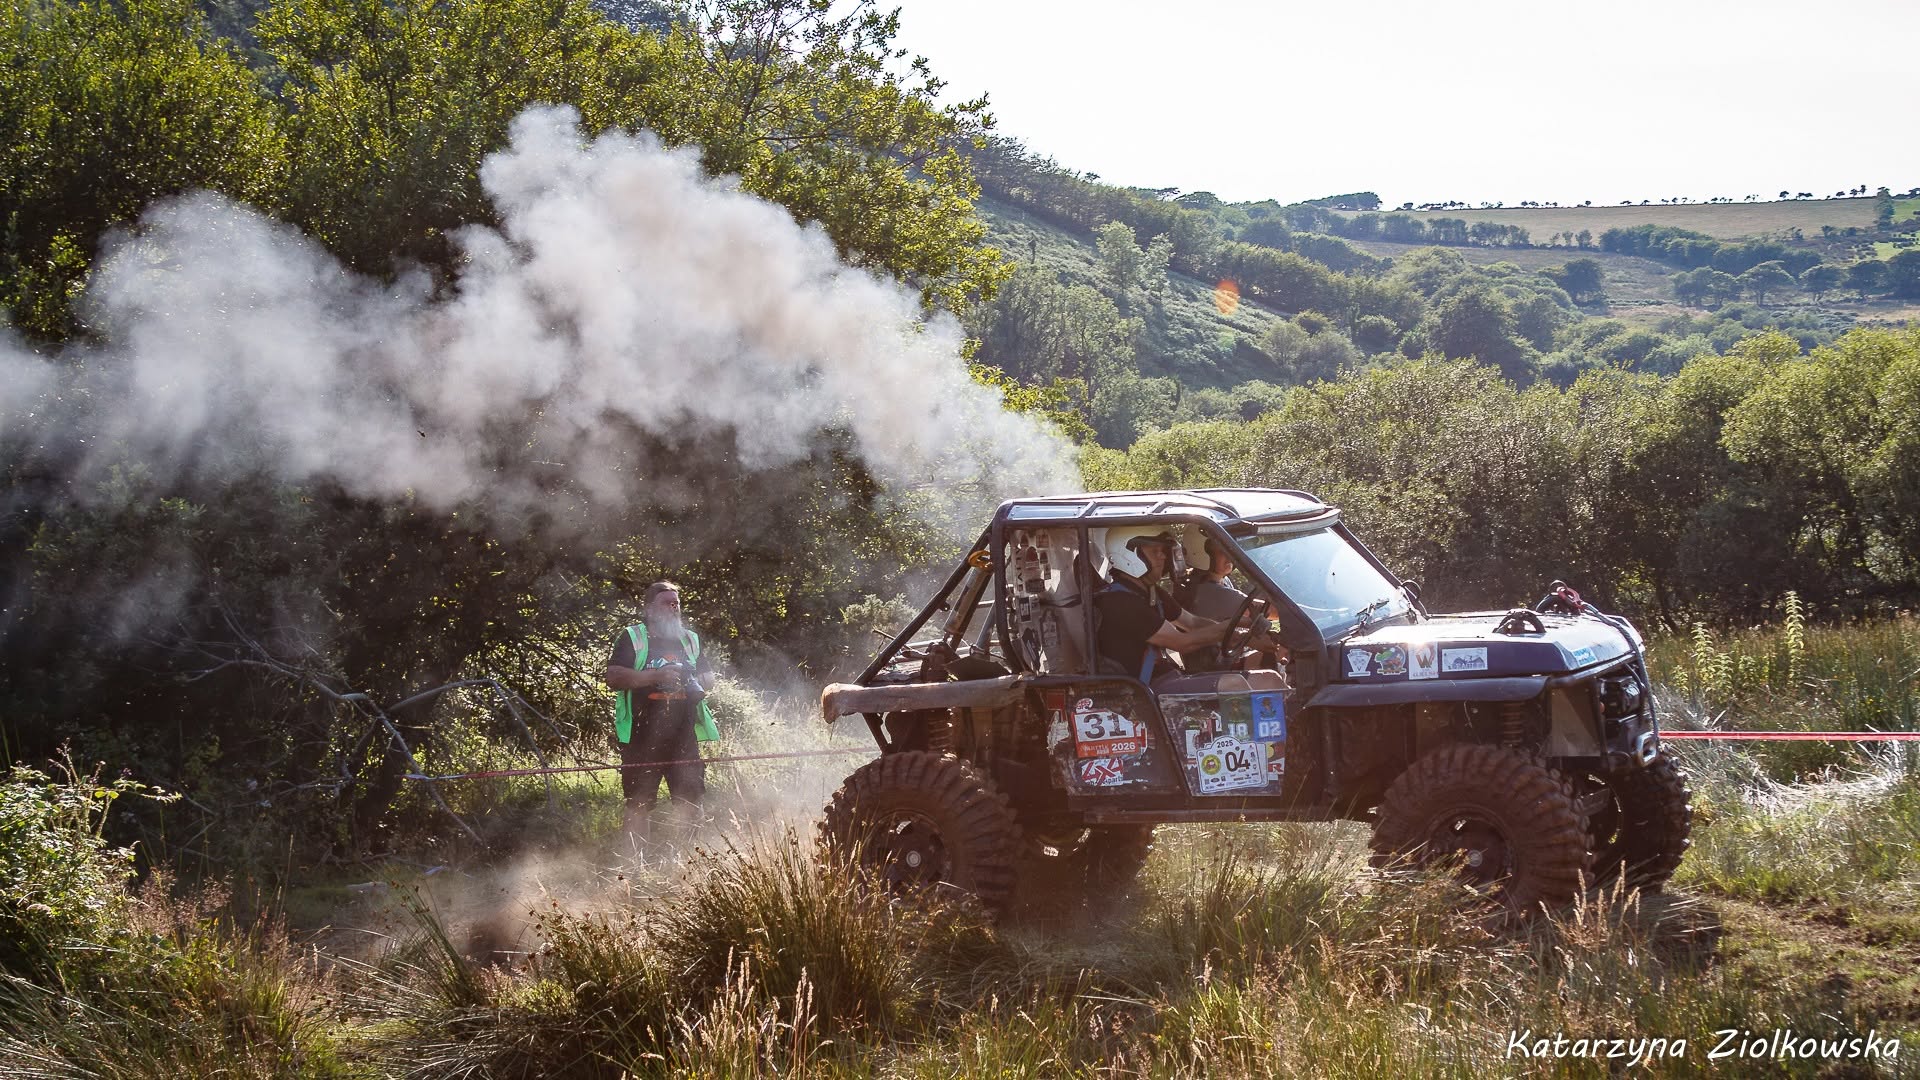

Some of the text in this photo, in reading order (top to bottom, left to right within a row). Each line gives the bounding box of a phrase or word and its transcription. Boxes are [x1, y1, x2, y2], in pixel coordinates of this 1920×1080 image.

[1083, 713, 1127, 739] 31
[1258, 721, 1282, 738] 02
[1111, 742, 1136, 751] 2026
[1216, 740, 1234, 749] 2025
[1225, 750, 1251, 772] 04
